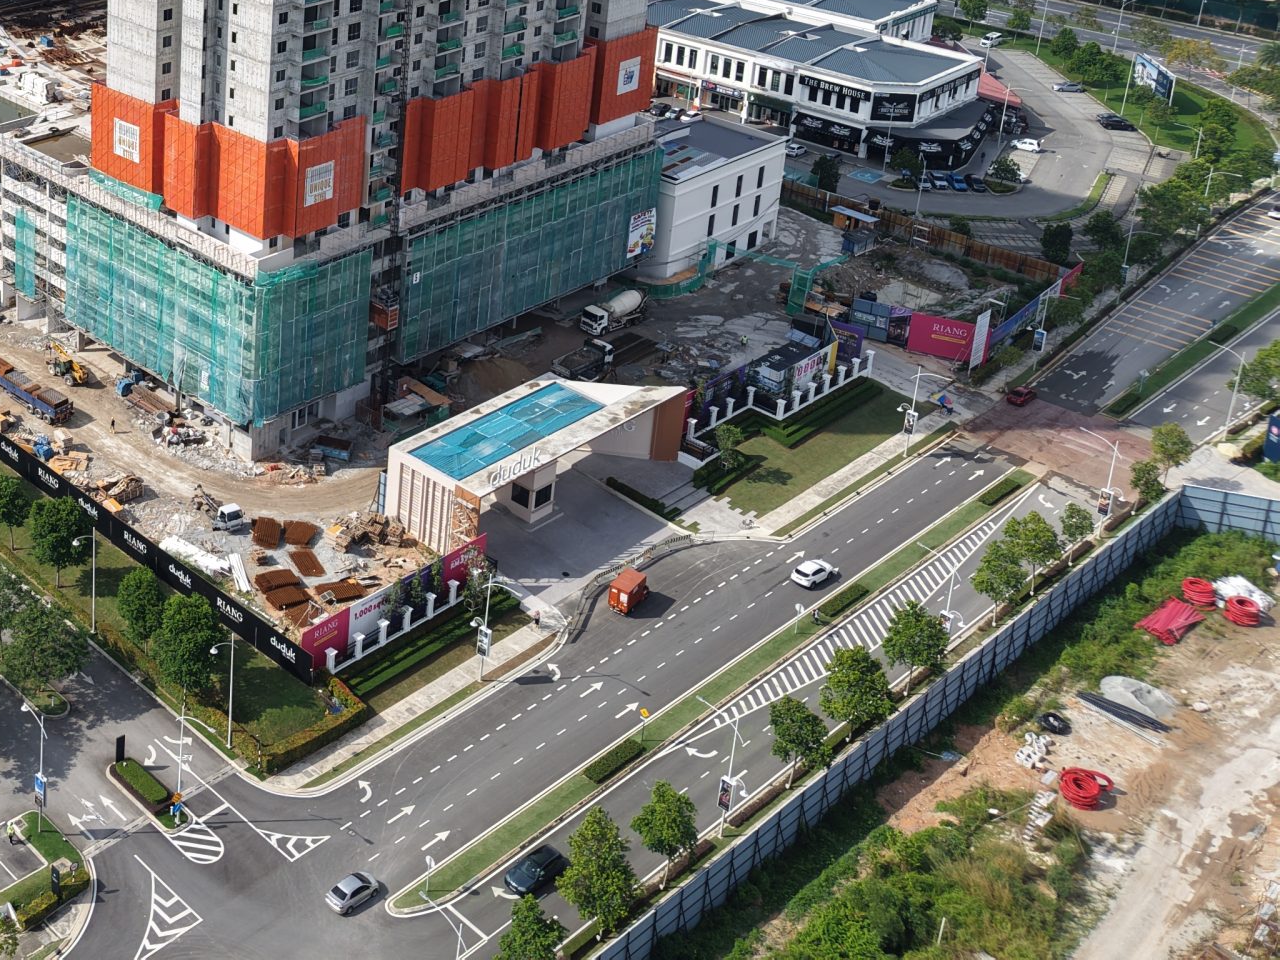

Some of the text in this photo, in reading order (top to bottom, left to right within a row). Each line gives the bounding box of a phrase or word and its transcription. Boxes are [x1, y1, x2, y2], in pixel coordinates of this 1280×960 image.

[805, 77, 865, 100] THE BREW HOUSE
[932, 323, 967, 337] RIANG
[0, 440, 19, 459] duduk
[490, 445, 541, 487] duduk
[38, 467, 59, 489] RIANG
[123, 530, 147, 554] RIANG
[168, 563, 192, 586] duduk
[216, 597, 243, 622] RIANG
[314, 619, 338, 638] RIANG
[270, 635, 296, 660] duduk
